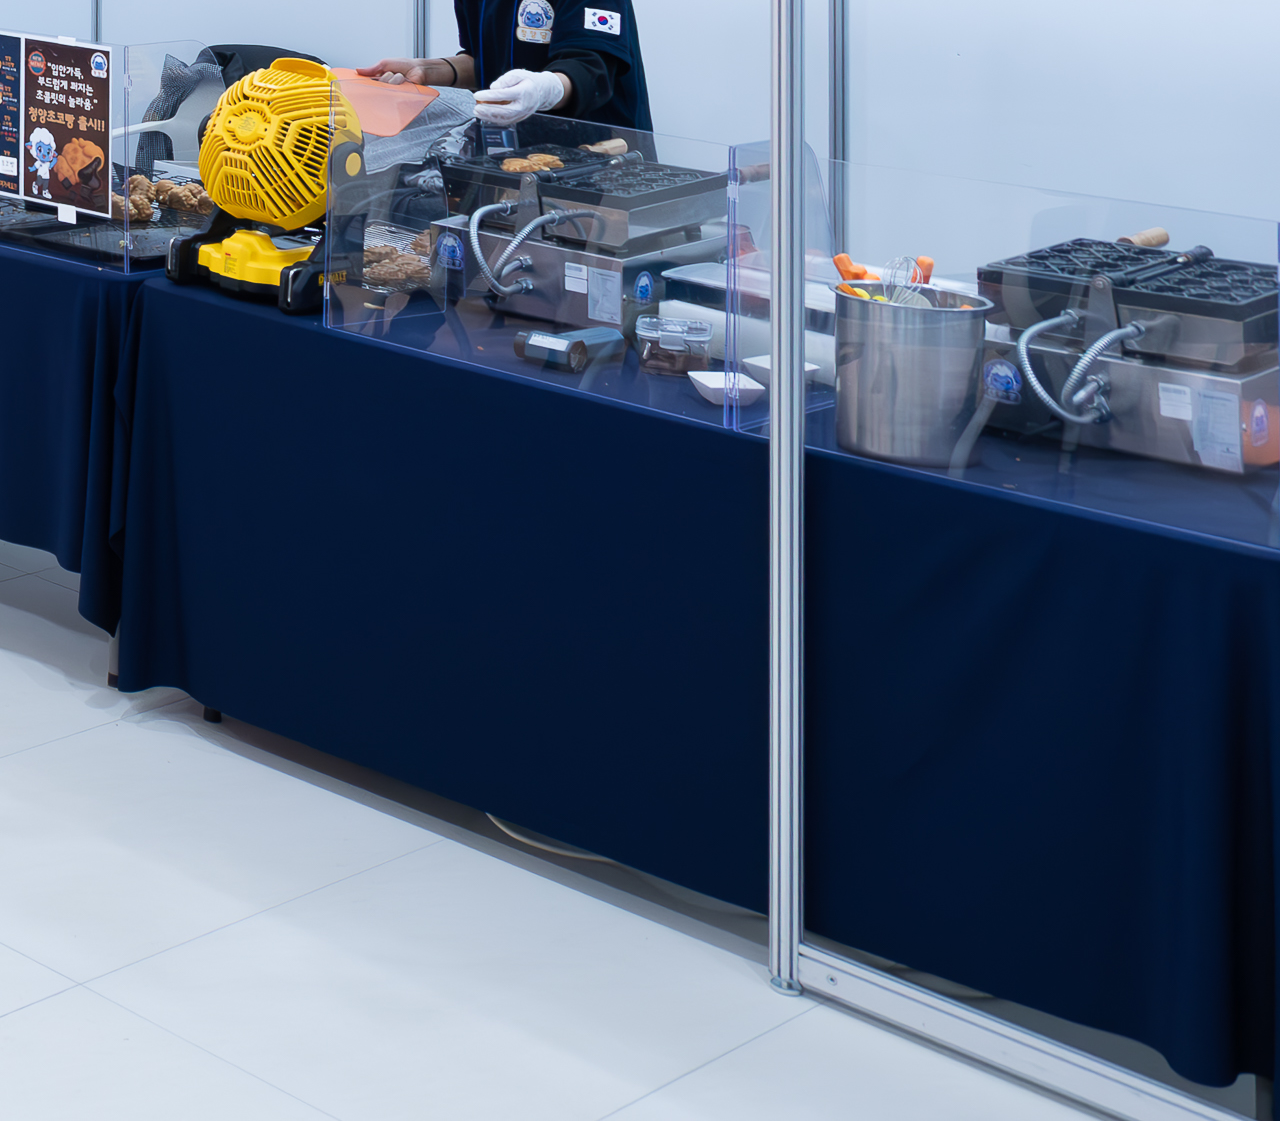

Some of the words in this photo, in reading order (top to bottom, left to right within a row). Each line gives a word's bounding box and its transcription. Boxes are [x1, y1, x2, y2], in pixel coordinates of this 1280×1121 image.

[37, 76, 68, 91] 부드럽게
[28, 106, 76, 129] 청양초코빵
[78, 115, 105, 132] 출시!!
